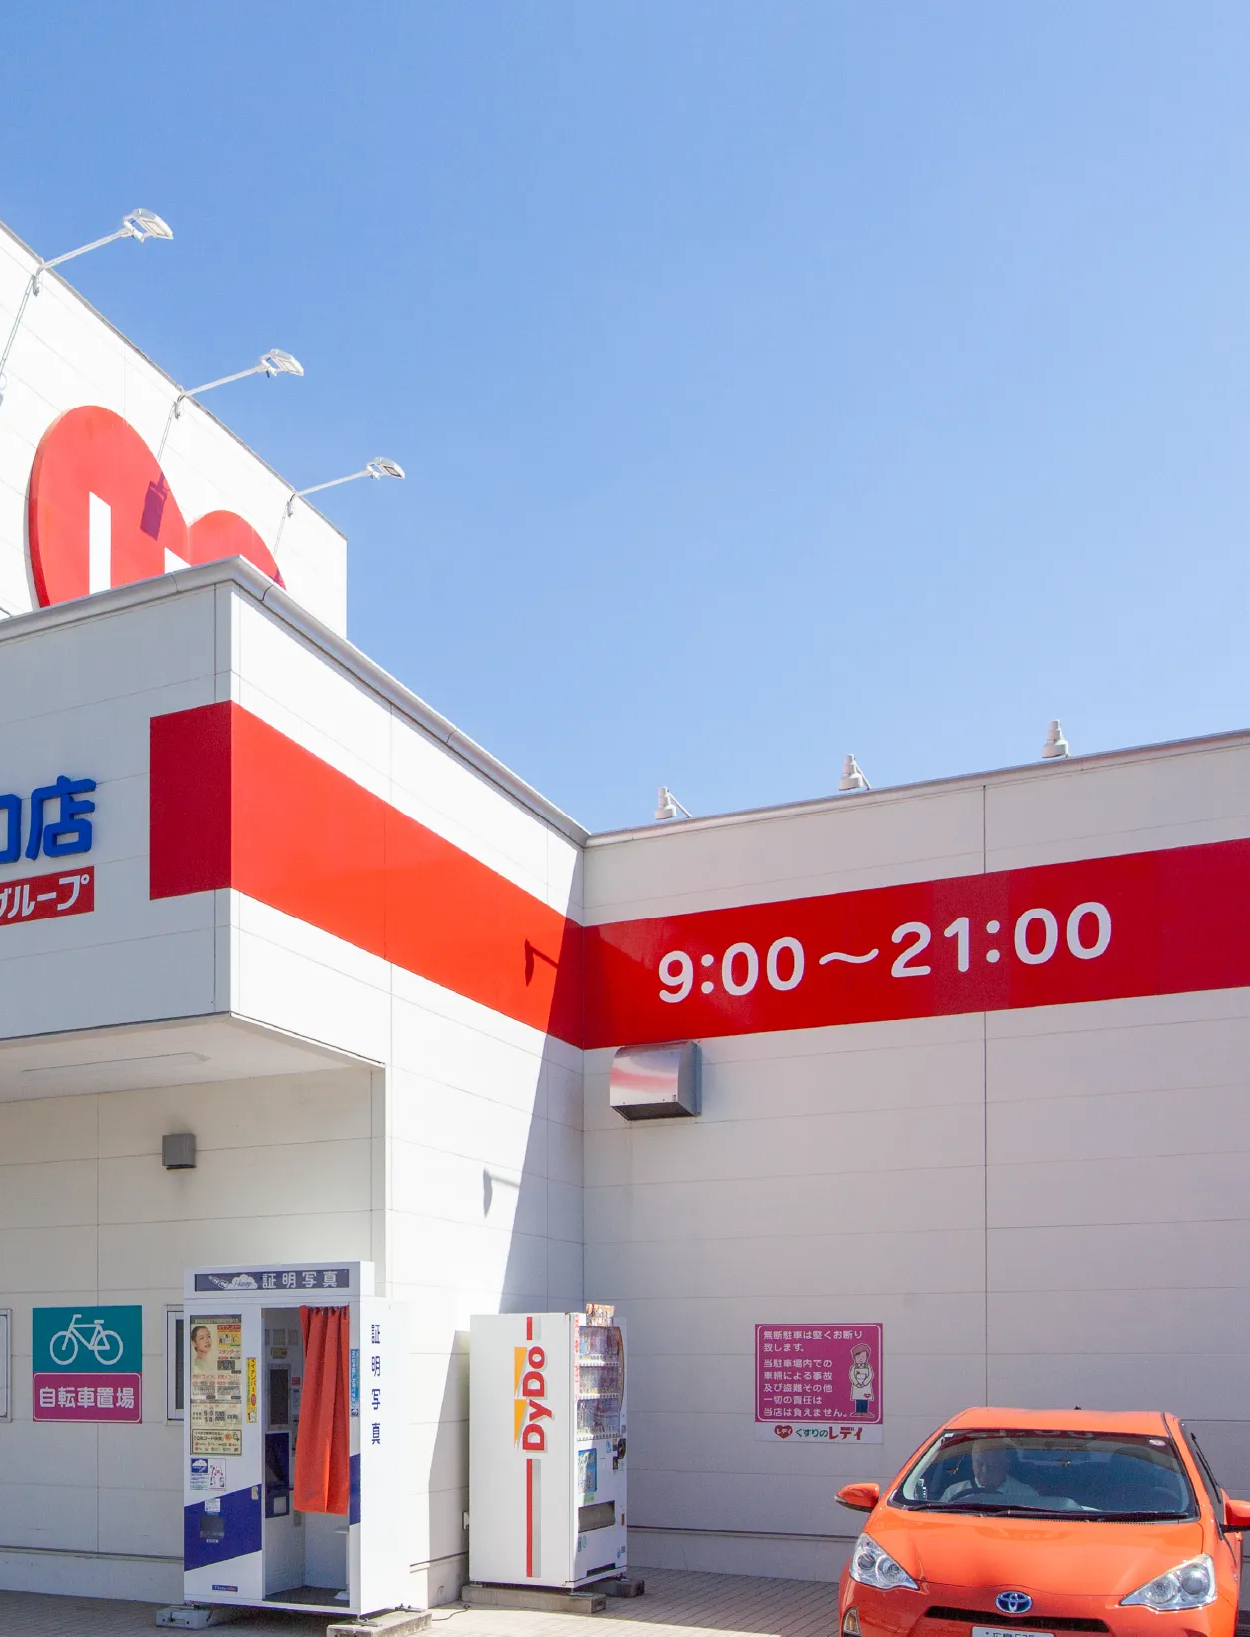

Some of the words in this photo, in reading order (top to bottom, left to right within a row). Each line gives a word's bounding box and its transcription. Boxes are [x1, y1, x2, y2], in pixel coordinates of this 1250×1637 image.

[262, 1271, 338, 1288] 証明写真
[763, 1330, 863, 1340] 無断駐車は堅くお断り
[763, 1343, 805, 1352] 致します。
[763, 1359, 832, 1369] 当駐車場内での
[371, 1324, 380, 1445] 証明写真
[763, 1384, 833, 1393] 及び盗難その他
[39, 1386, 135, 1409] 自転車置場
[522, 1345, 553, 1451] DyDo
[763, 1396, 823, 1405] 一切の責任は
[763, 1408, 849, 1418] 当店は負えません。
